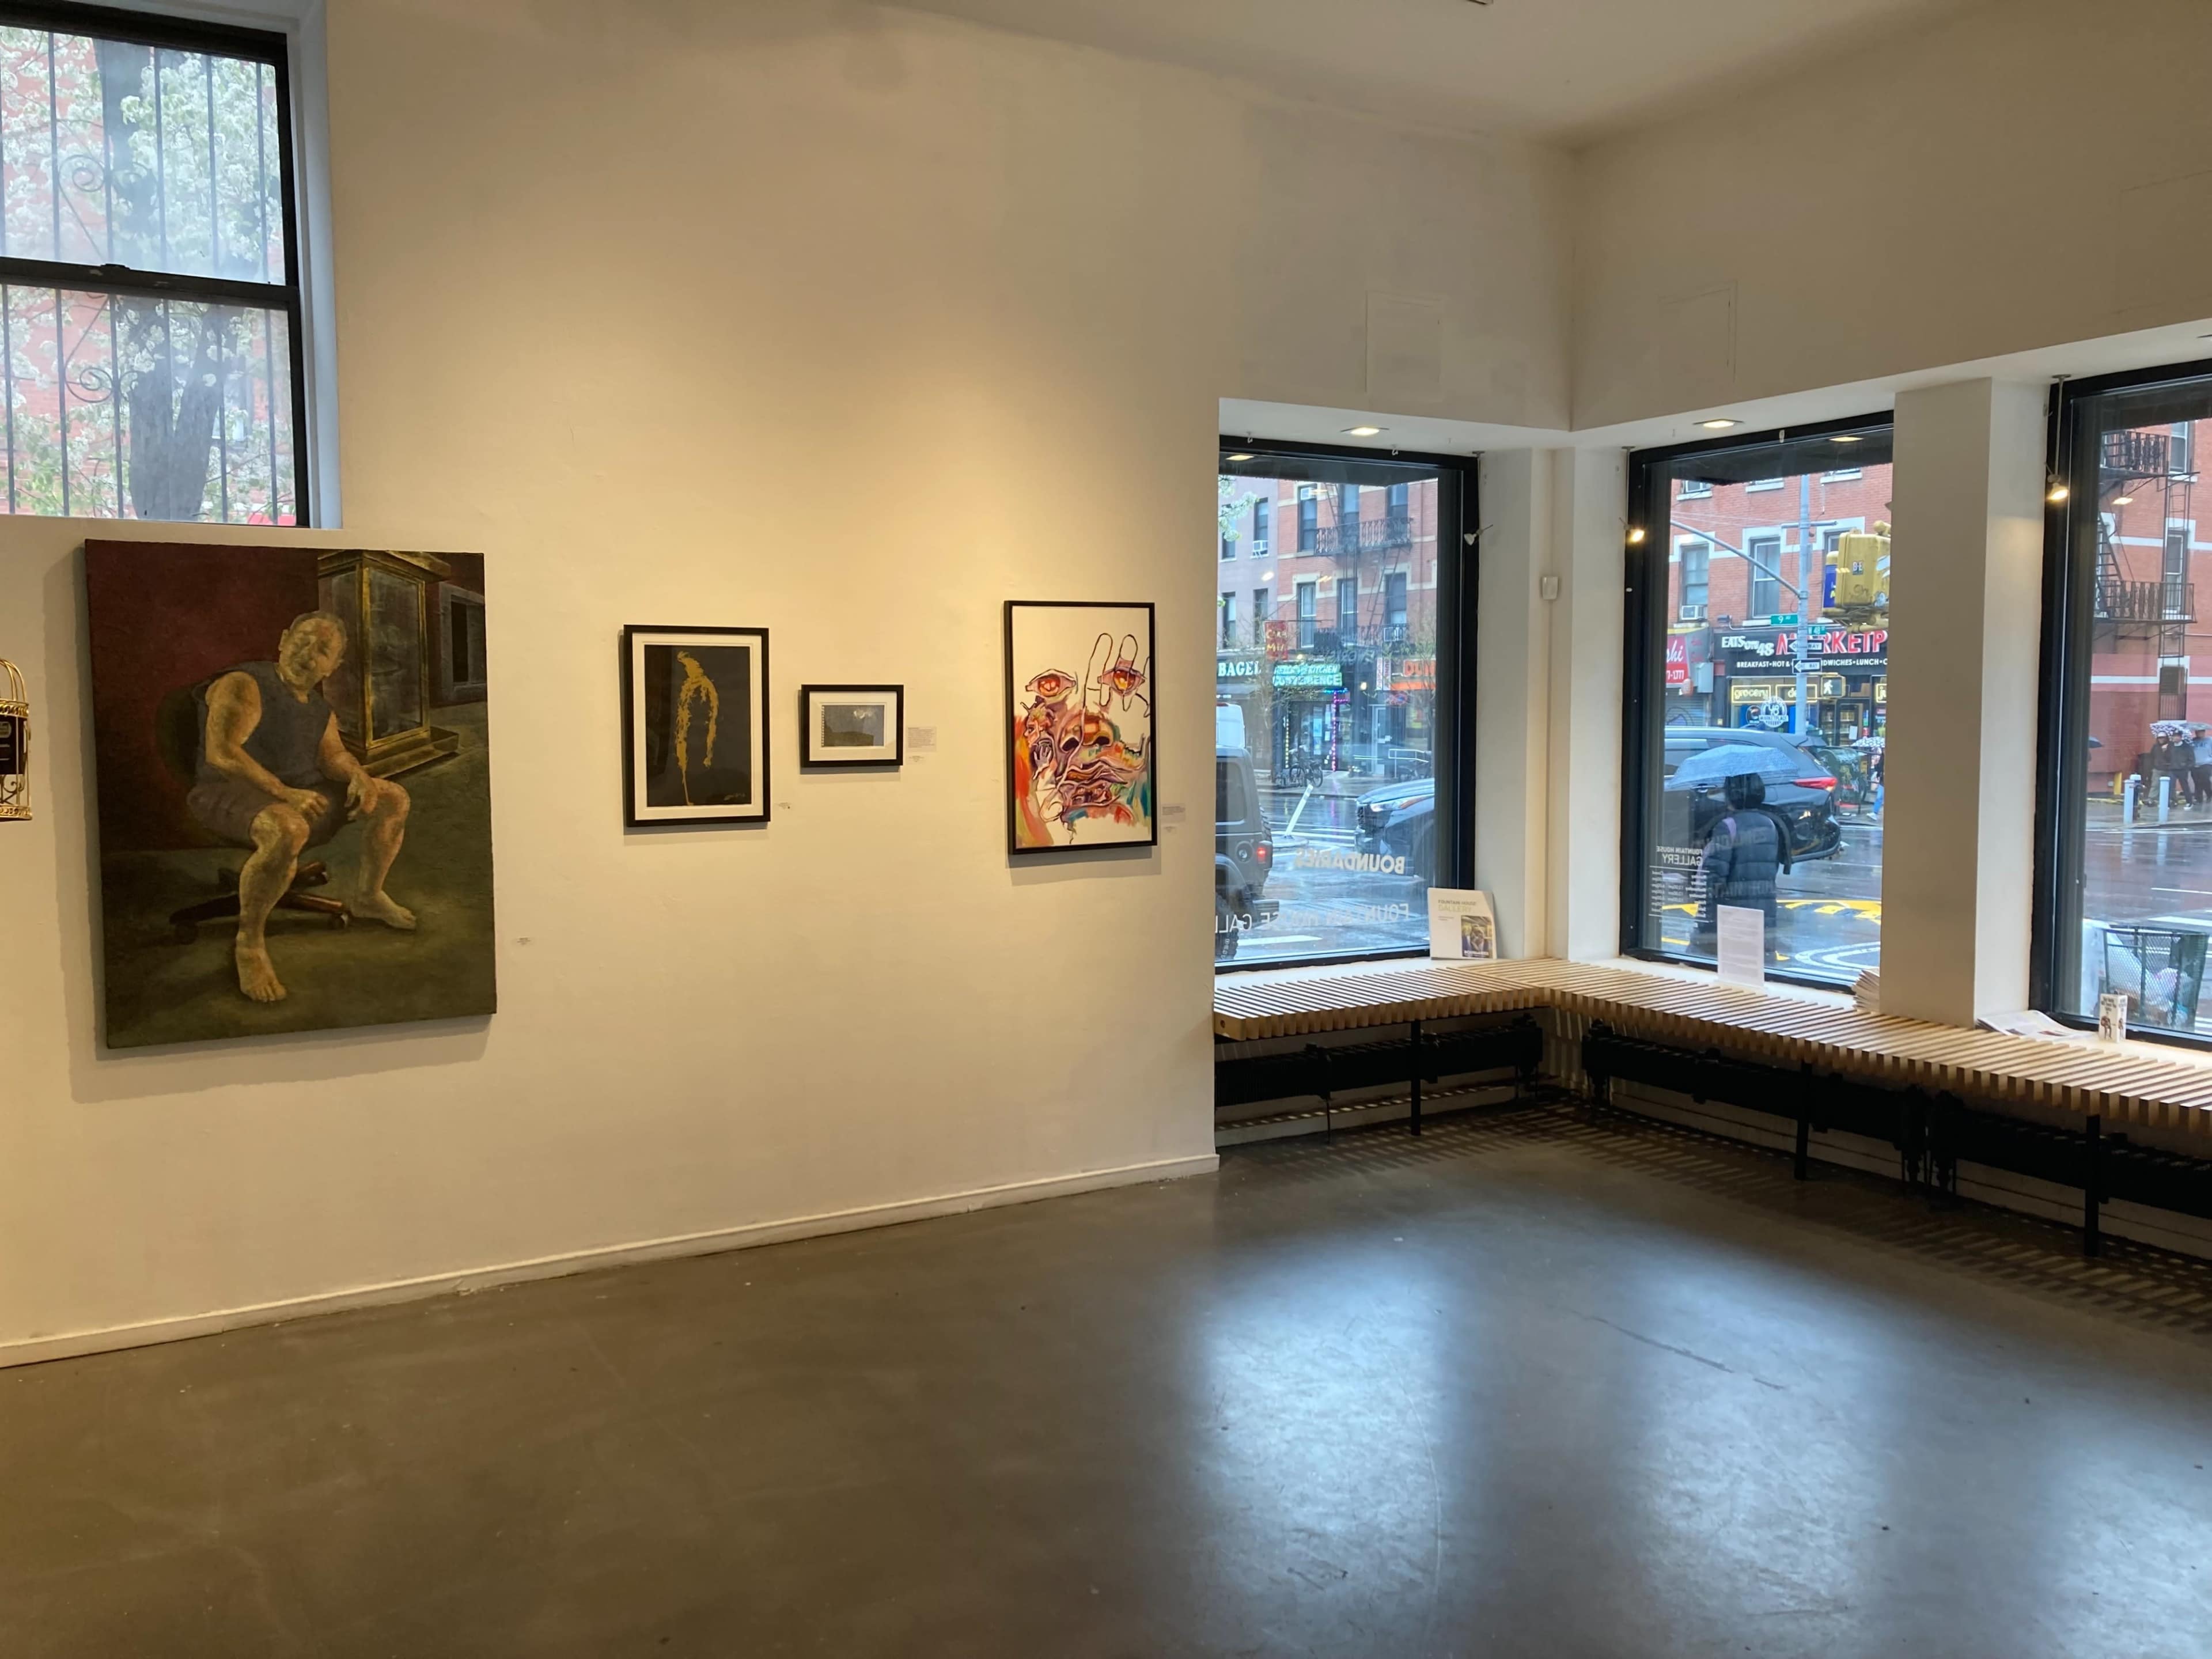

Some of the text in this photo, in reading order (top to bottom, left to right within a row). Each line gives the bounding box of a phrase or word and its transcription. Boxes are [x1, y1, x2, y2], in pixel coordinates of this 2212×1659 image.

[1778, 615, 1784, 624] 9
[1813, 626, 1821, 634] 48
[1721, 635, 1746, 648] EATS
[1756, 642, 1775, 657] 48
[1217, 661, 1262, 677] BAGEL
[1308, 664, 1338, 675] KITCHEN
[1734, 688, 1769, 700] grocery
